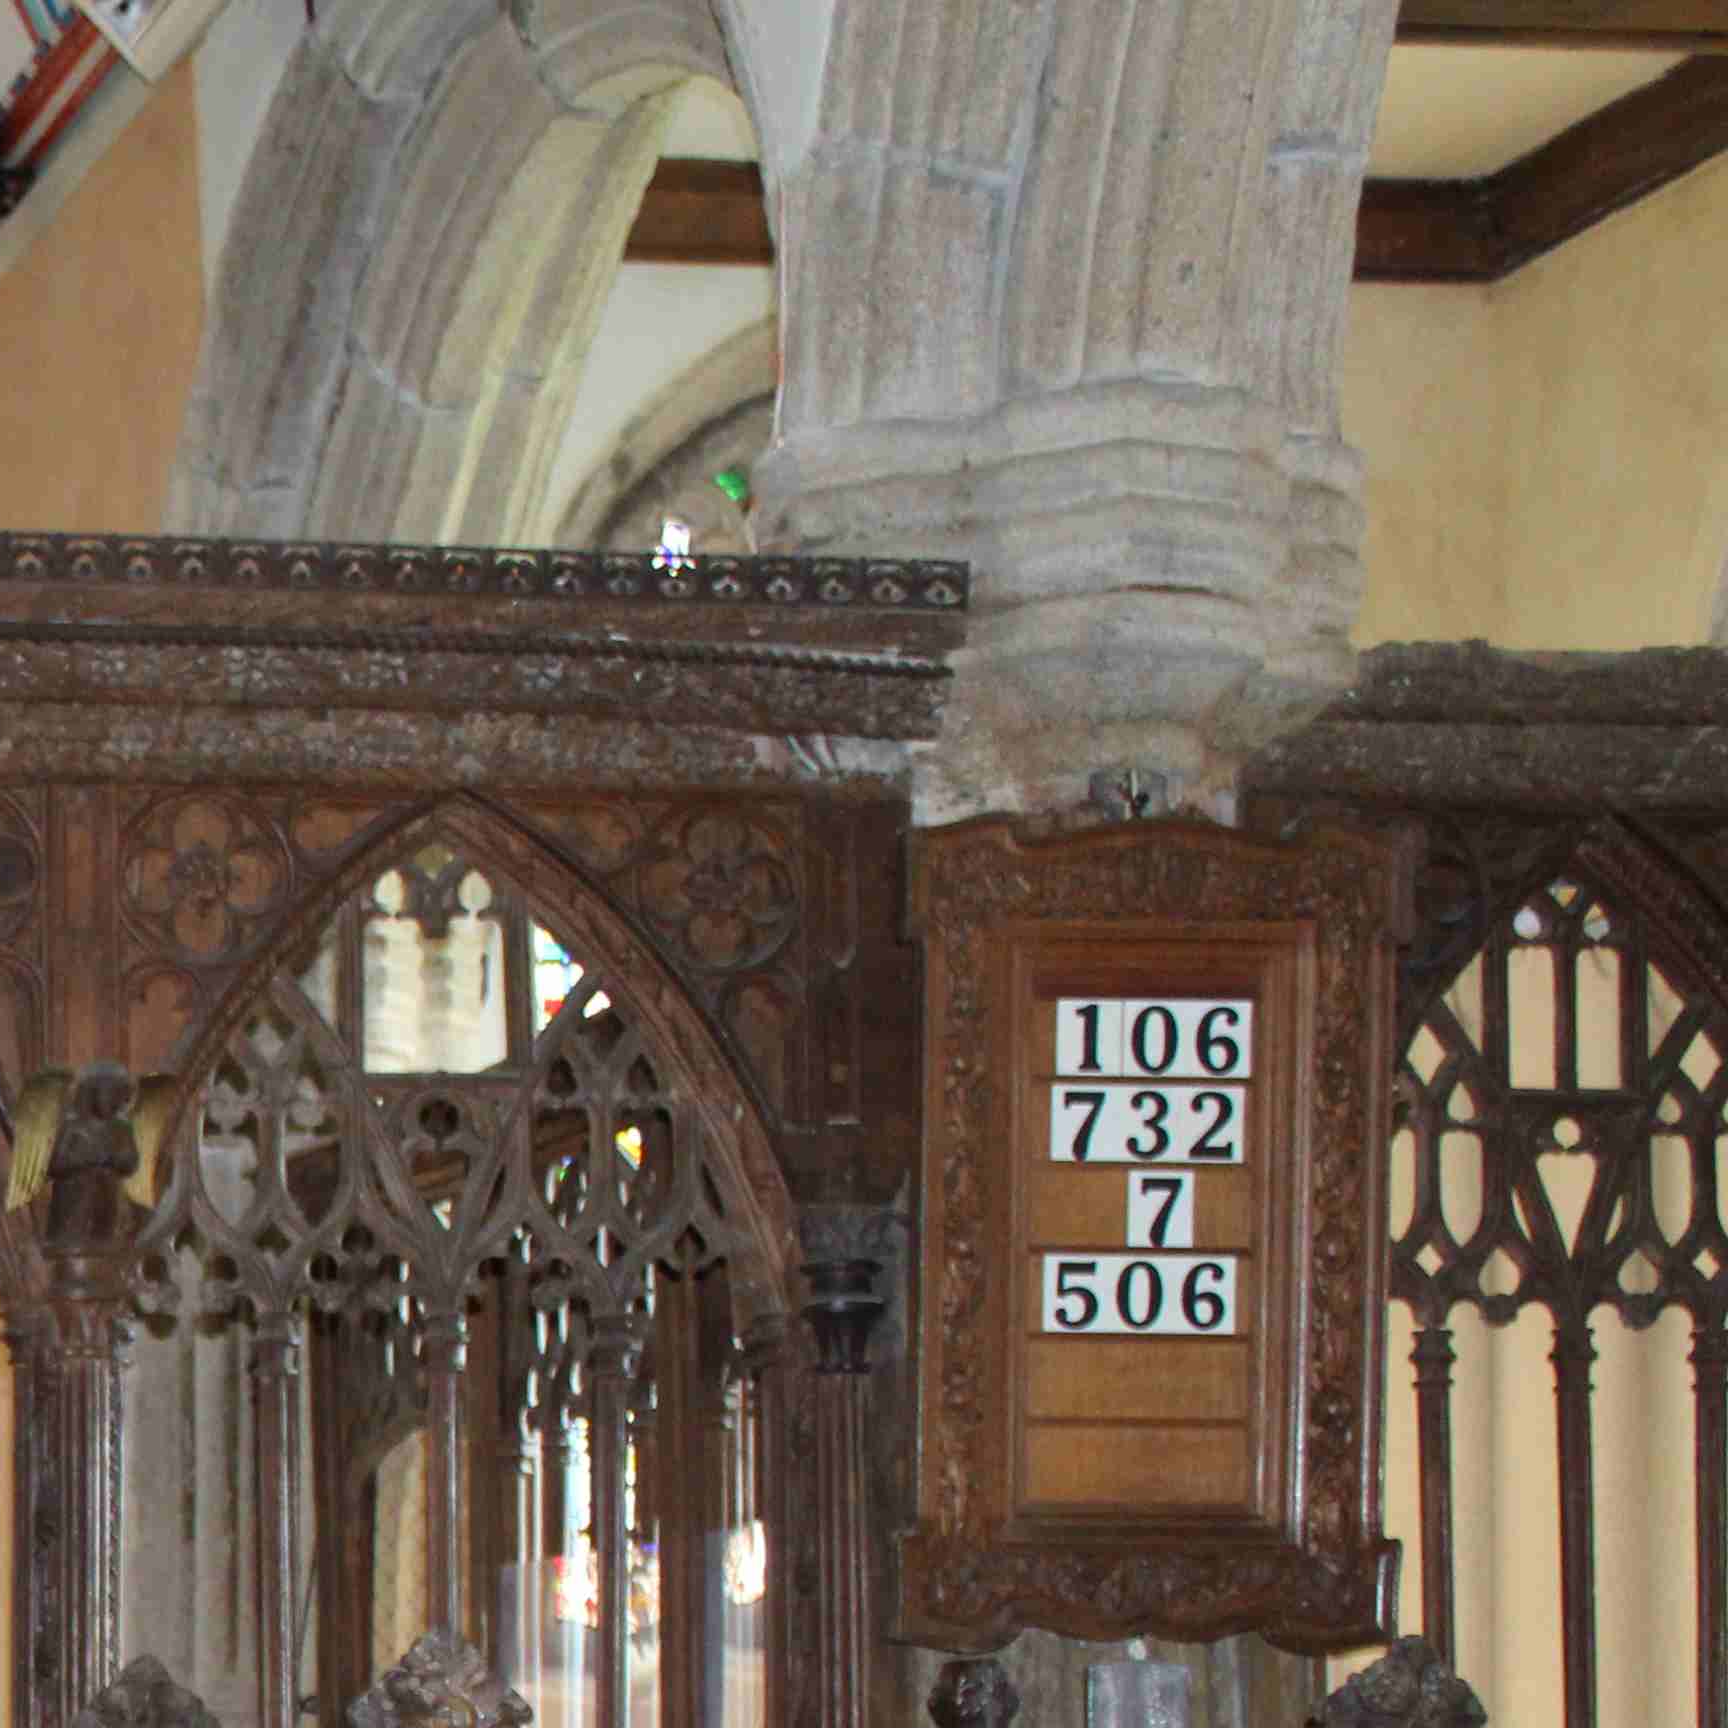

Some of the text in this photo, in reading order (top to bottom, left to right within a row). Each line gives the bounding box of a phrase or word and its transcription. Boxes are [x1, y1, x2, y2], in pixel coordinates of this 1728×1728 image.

[1074, 1003, 1240, 1074] 106
[1062, 1090, 1234, 1161] 732
[1140, 1178, 1183, 1247] 7
[1054, 1260, 1226, 1329] 506
